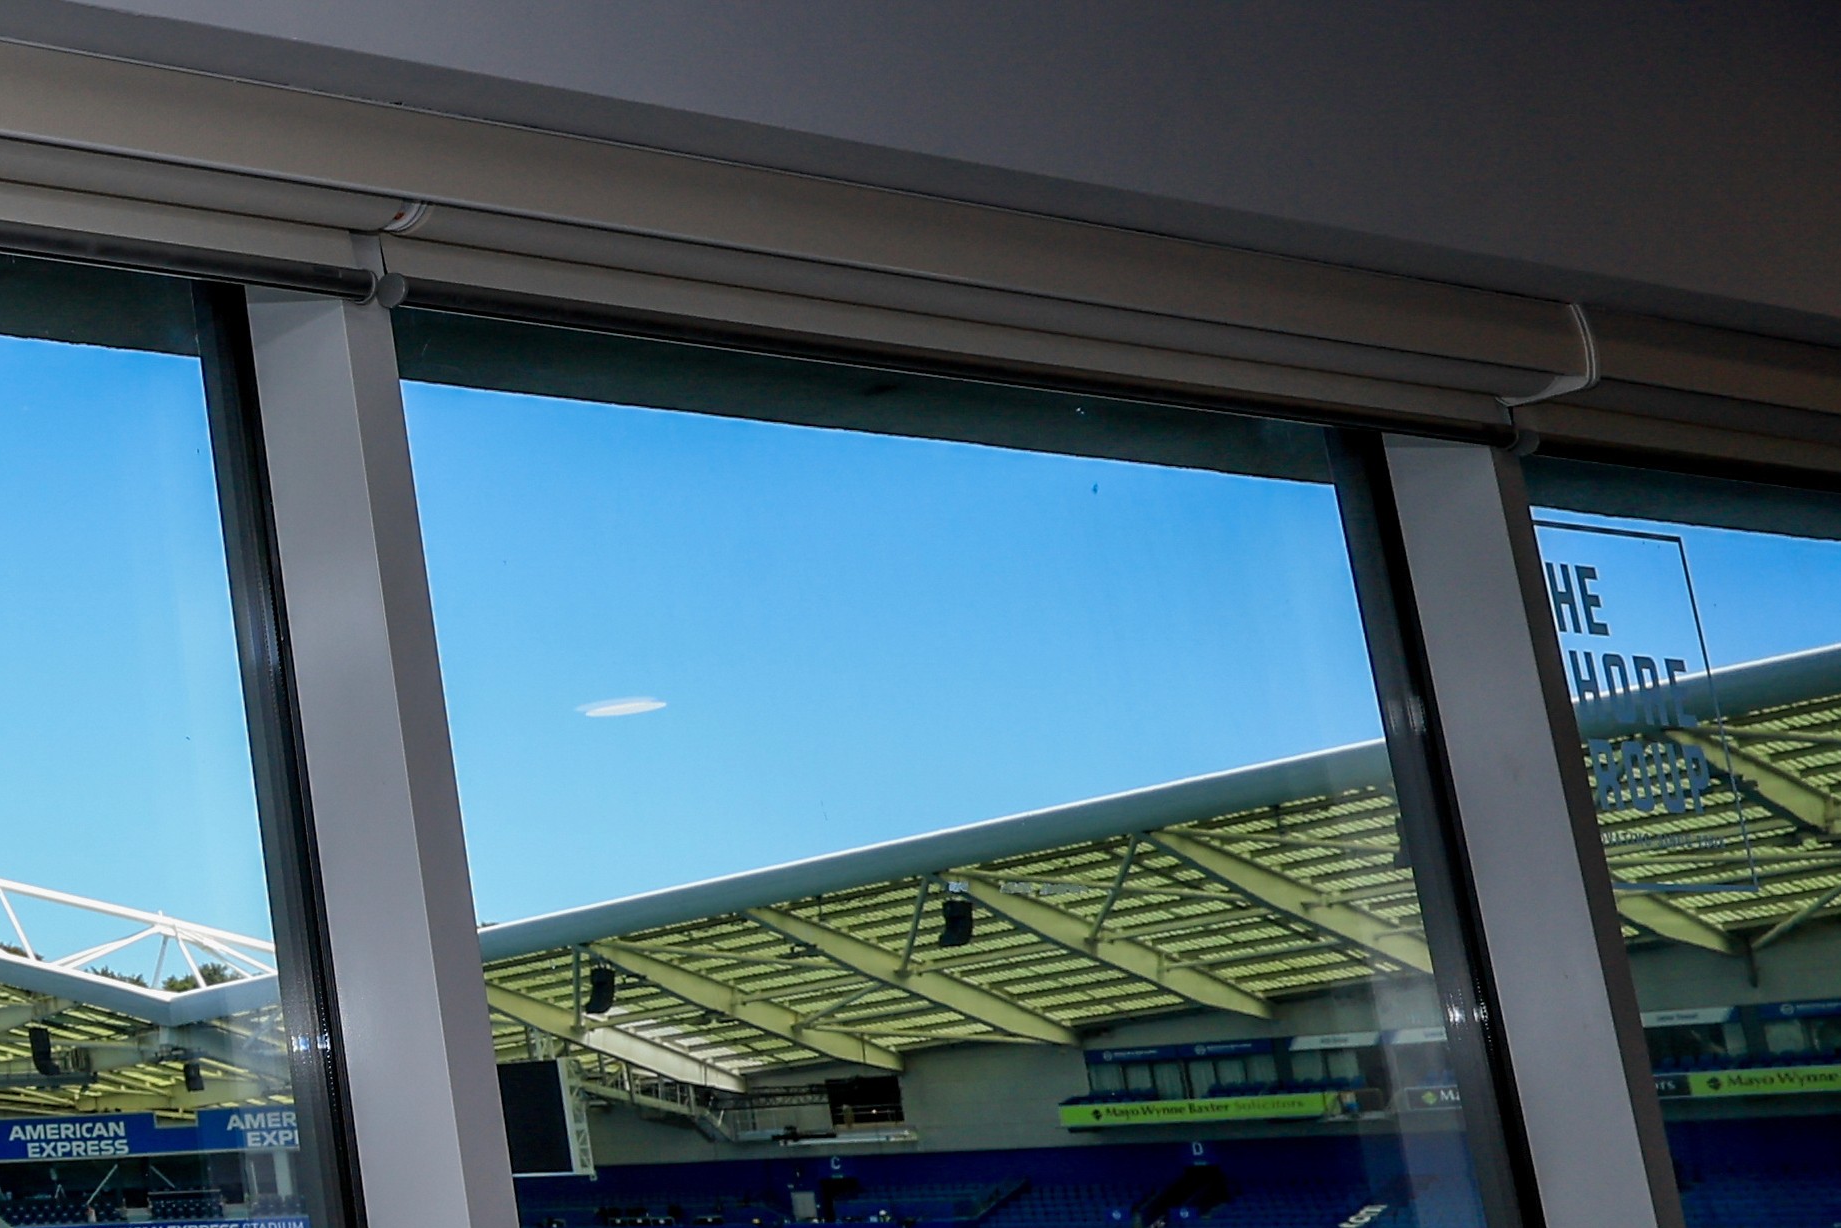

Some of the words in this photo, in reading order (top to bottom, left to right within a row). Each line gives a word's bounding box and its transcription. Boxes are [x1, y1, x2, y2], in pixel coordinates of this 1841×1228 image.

[1545, 562, 1609, 636] HE
[1569, 650, 1697, 728] HORE
[1589, 739, 1710, 814] ROUP
[1776, 1072, 1838, 1087] Wynne
[1140, 1104, 1185, 1119] Wynne
[1189, 1102, 1229, 1114] Baxter
[9, 1121, 126, 1141] AMERICAN
[227, 1111, 297, 1132] AMER
[27, 1139, 129, 1159] EXPRESS
